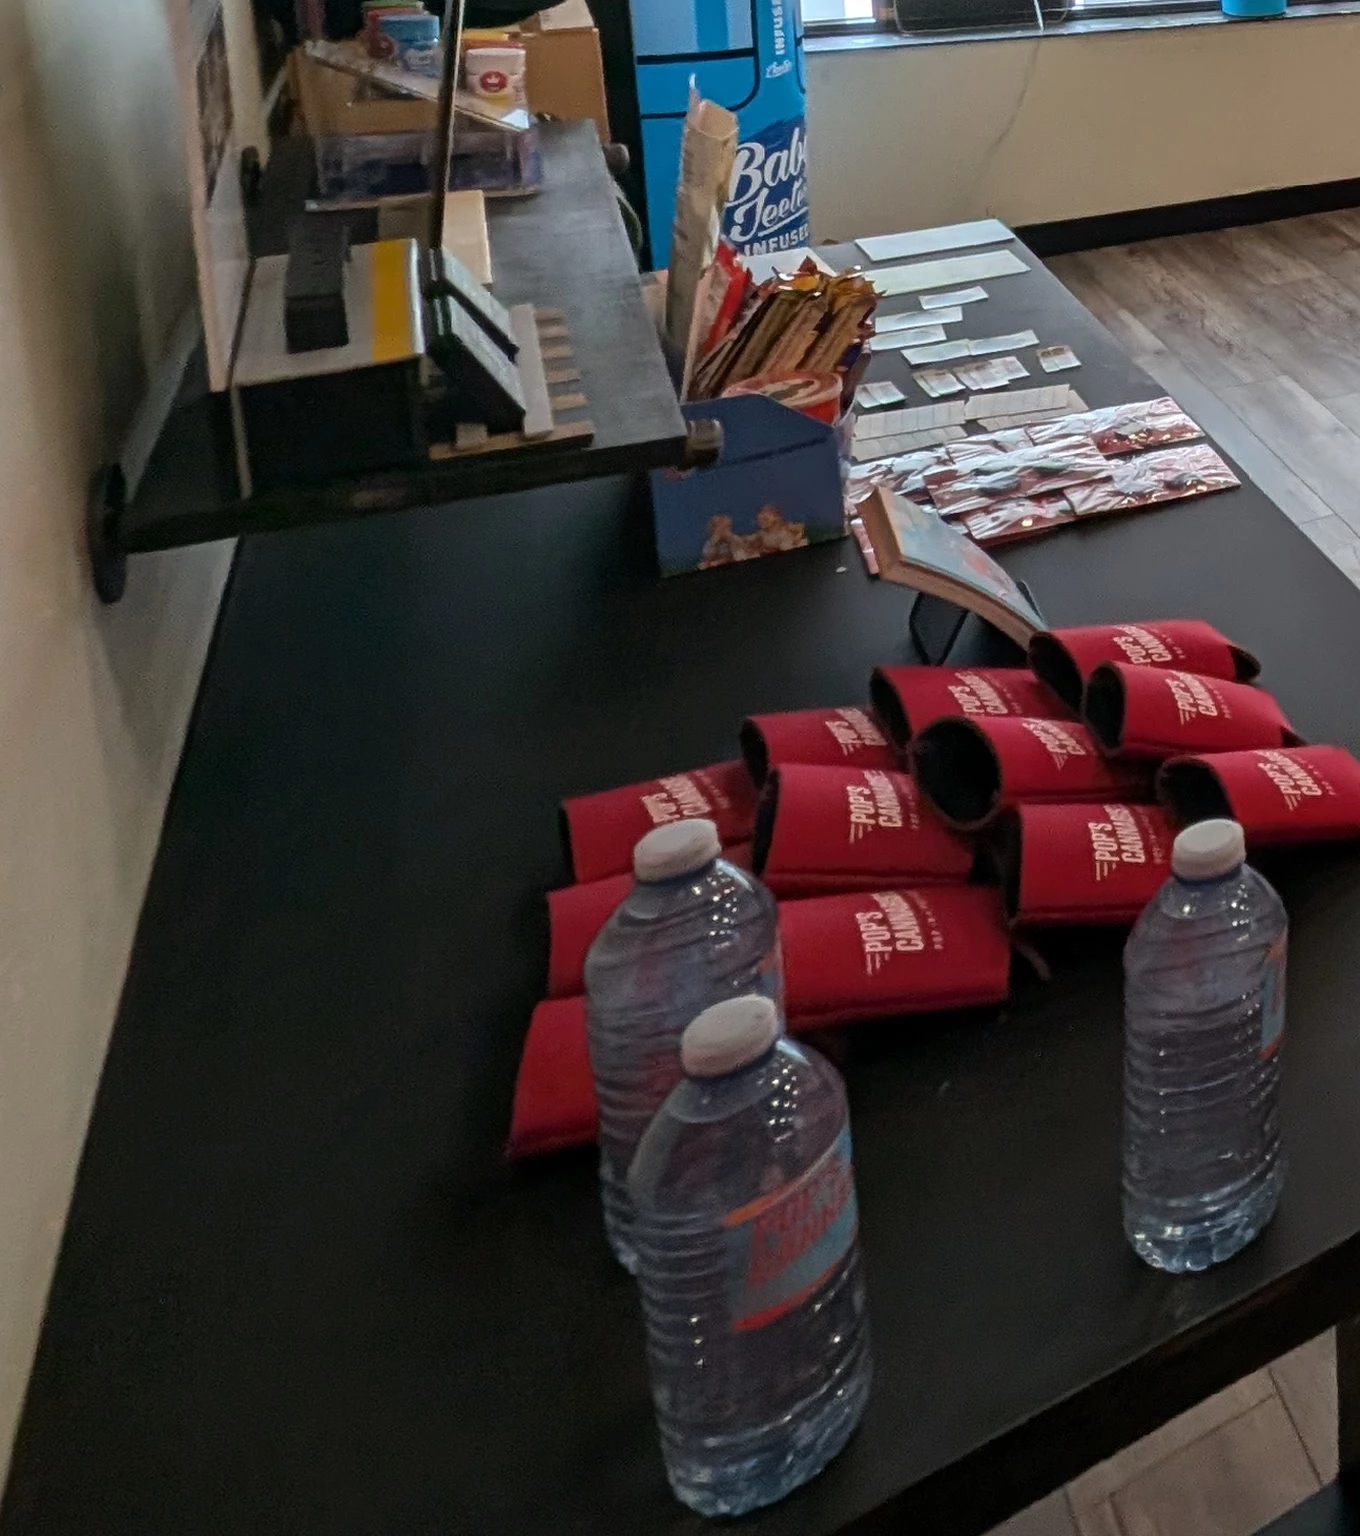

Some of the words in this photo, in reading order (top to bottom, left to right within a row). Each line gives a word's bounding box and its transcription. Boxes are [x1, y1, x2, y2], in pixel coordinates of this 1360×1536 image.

[847, 785, 875, 824] POP'S
[1088, 823, 1119, 861] POP'S
[856, 912, 892, 952] POP'S
